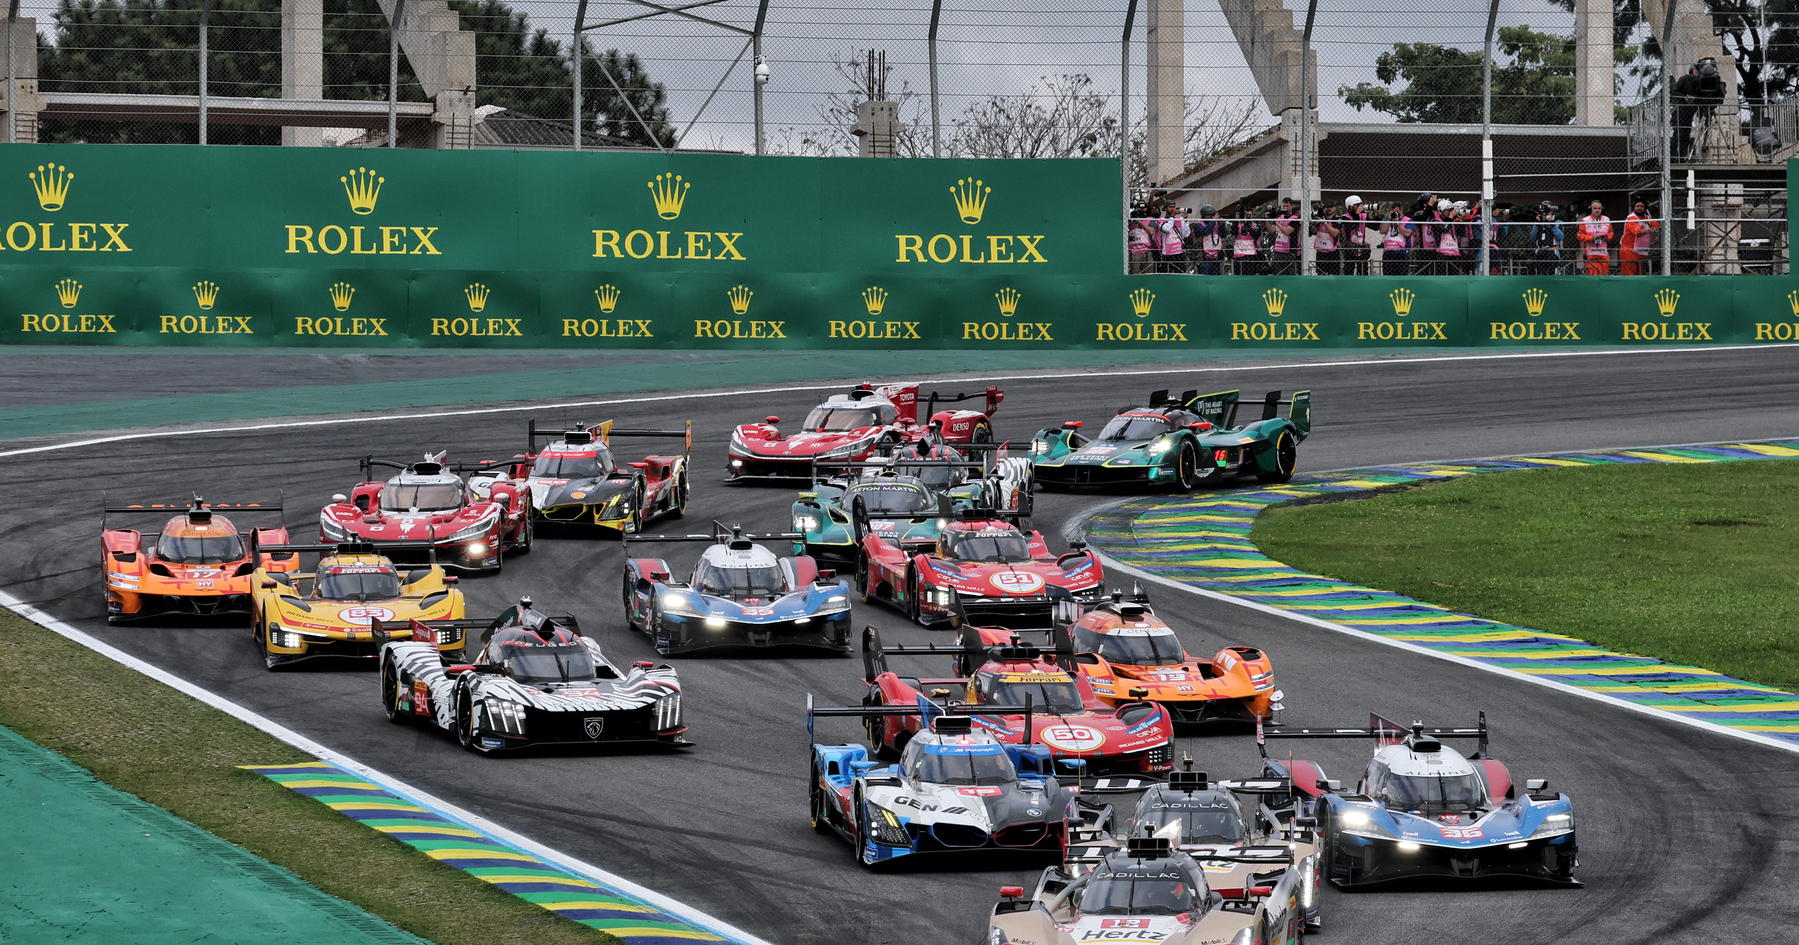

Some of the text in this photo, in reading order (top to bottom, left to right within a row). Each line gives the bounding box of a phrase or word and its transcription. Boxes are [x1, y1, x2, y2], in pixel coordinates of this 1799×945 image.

[0, 222, 132, 252] OLEX
[285, 224, 441, 256] ROLEX
[592, 230, 746, 262] ROLEX
[896, 234, 1047, 265] ROLEX
[22, 314, 116, 334] ROLEX
[160, 316, 252, 335] ROLEX
[296, 317, 390, 337] ROLEX
[431, 318, 523, 338] ROLEX
[562, 319, 654, 339] ROLEX
[695, 320, 787, 341] ROLEX
[829, 321, 921, 342] ROLEX
[963, 322, 1054, 342] ROLEX
[1096, 323, 1189, 342] ROLEX
[1231, 323, 1321, 341] ROLEX
[1358, 322, 1449, 341] ROLEX
[1490, 322, 1582, 341] ROLEX
[1621, 323, 1714, 341] ROLEX
[899, 392, 915, 402] TOYOTA
[952, 421, 970, 432] DENSO
[1133, 416, 1165, 424] MARTIN
[1214, 449, 1227, 461] 16
[883, 486, 918, 494] MARTIN
[198, 580, 213, 588] HY
[1001, 572, 1034, 585] 51
[1070, 571, 1094, 582] CEVA
[742, 607, 776, 617] 35
[1159, 673, 1187, 681] 13
[1177, 684, 1194, 692] HY
[413, 691, 431, 714] 94
[1053, 728, 1091, 740] 50
[1136, 726, 1162, 738] CEVA
[1118, 735, 1163, 748] RICHARD MILLE
[893, 796, 939, 813] GEN
[1441, 827, 1482, 838] 36
[1096, 871, 1180, 879] CADILLAC
[1108, 919, 1142, 929] 12
[1080, 928, 1170, 942] Hertz
